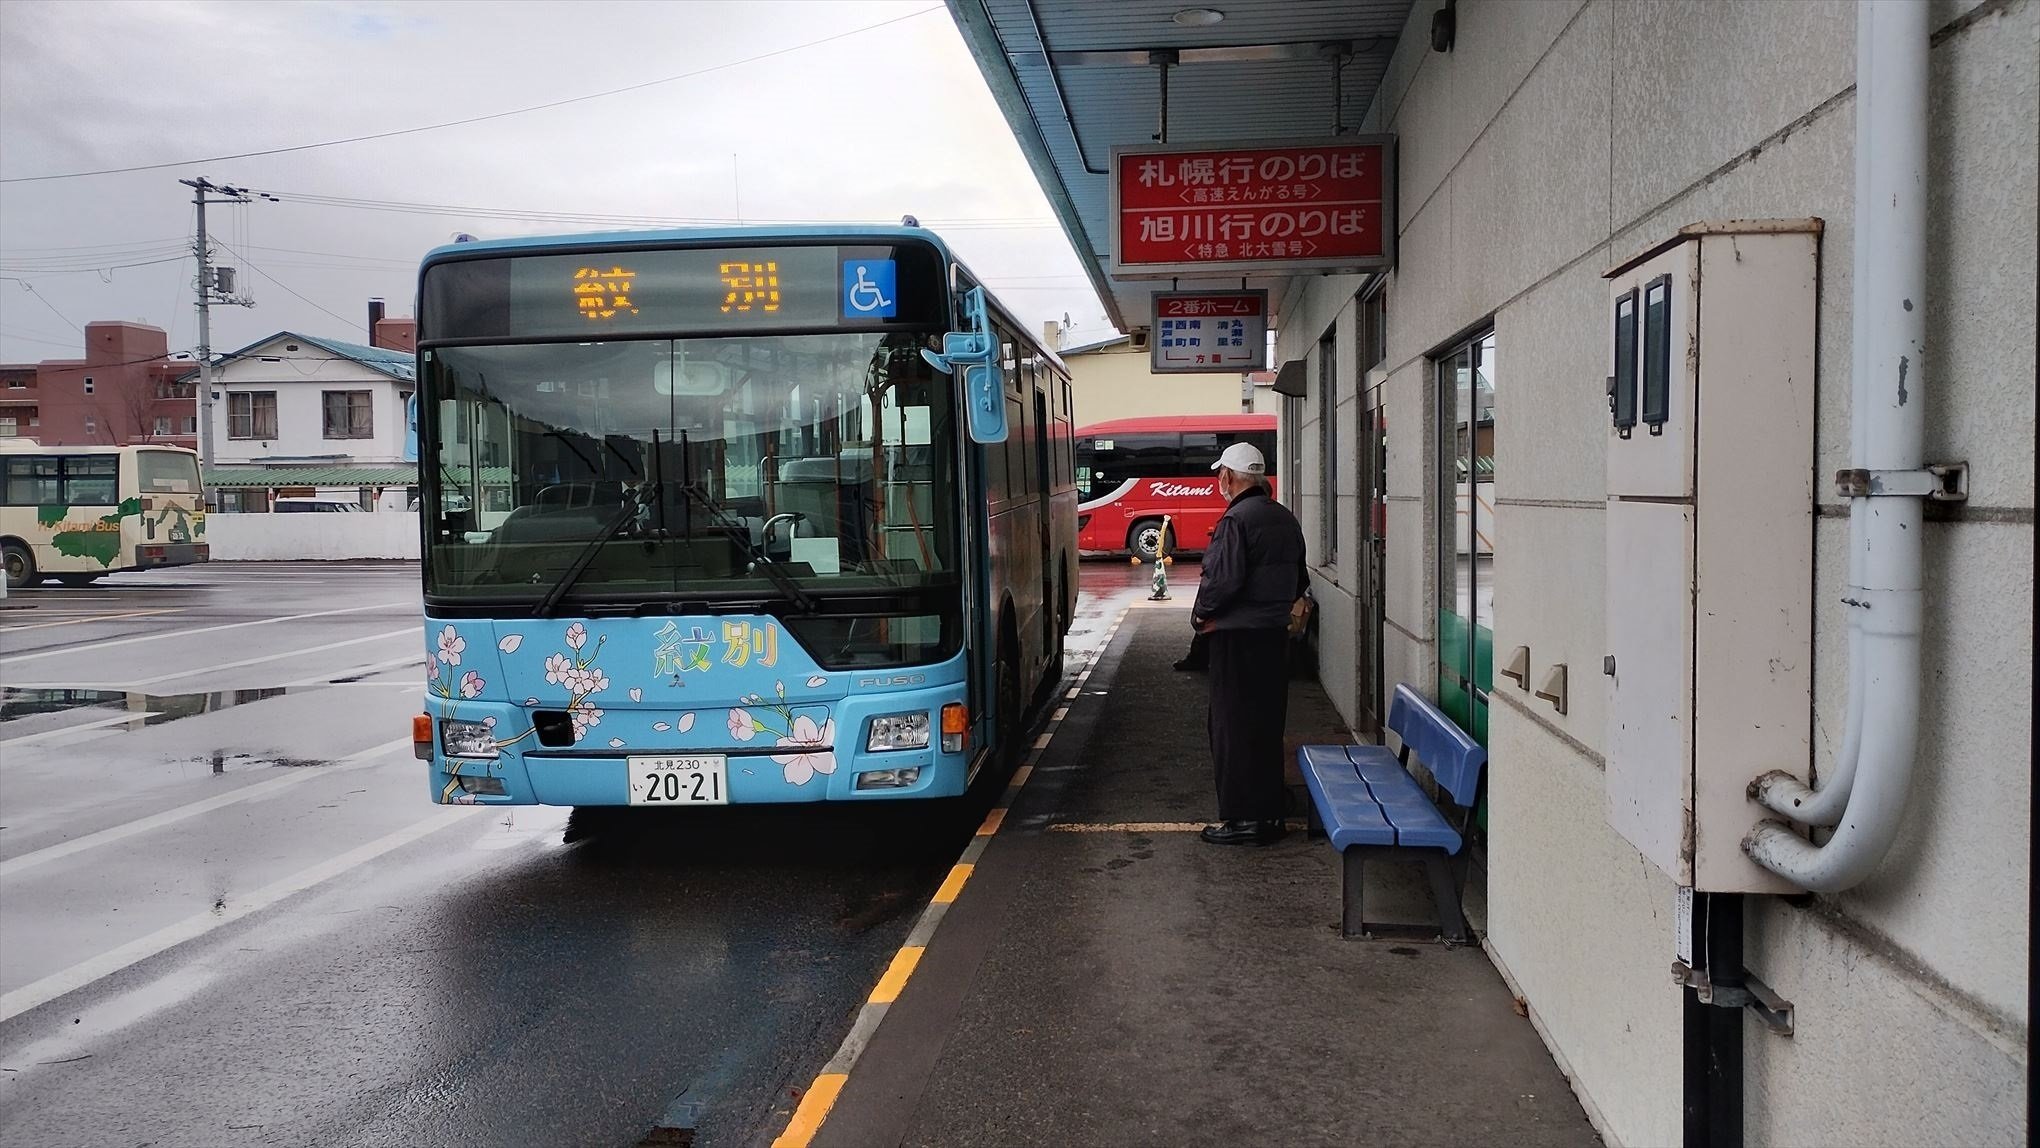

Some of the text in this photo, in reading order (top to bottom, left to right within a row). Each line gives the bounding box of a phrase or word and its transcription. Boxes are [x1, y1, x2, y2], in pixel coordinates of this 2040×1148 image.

[1139, 153, 1366, 187] 札幌行のりば
[1140, 209, 1367, 242] 旭川行のりば
[1168, 300, 1250, 314] 2番ホーム
[1150, 481, 1213, 497] Kitami
[95, 520, 120, 532] Bus
[653, 619, 779, 679] 紋別
[858, 673, 926, 687] FUSO
[654, 759, 700, 770] 北見230
[646, 771, 720, 801] 20-21
